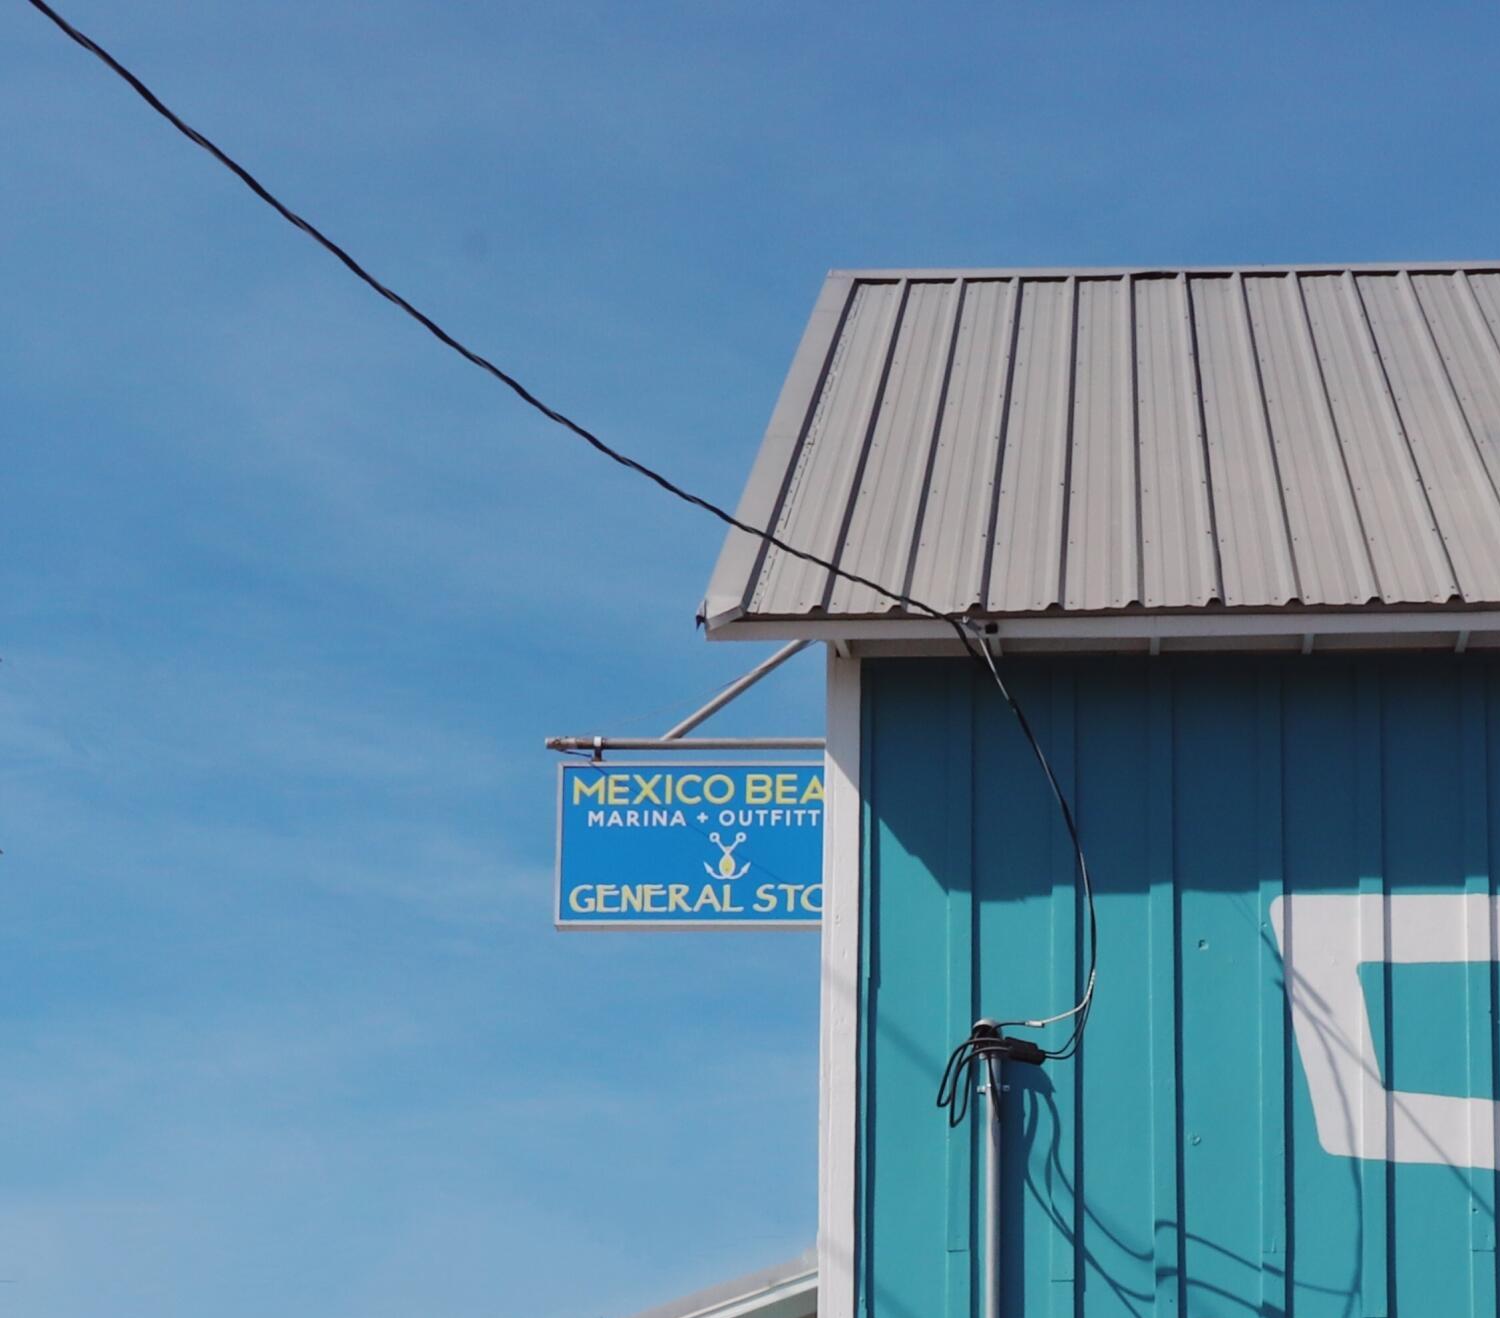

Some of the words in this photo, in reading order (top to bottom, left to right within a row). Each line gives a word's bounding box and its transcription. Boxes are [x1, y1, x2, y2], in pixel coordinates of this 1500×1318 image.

[572, 773, 735, 805] MEXICO
[587, 809, 687, 828] MARINA
[718, 808, 821, 827] OUTFITT
[568, 883, 744, 913] GENERAL
